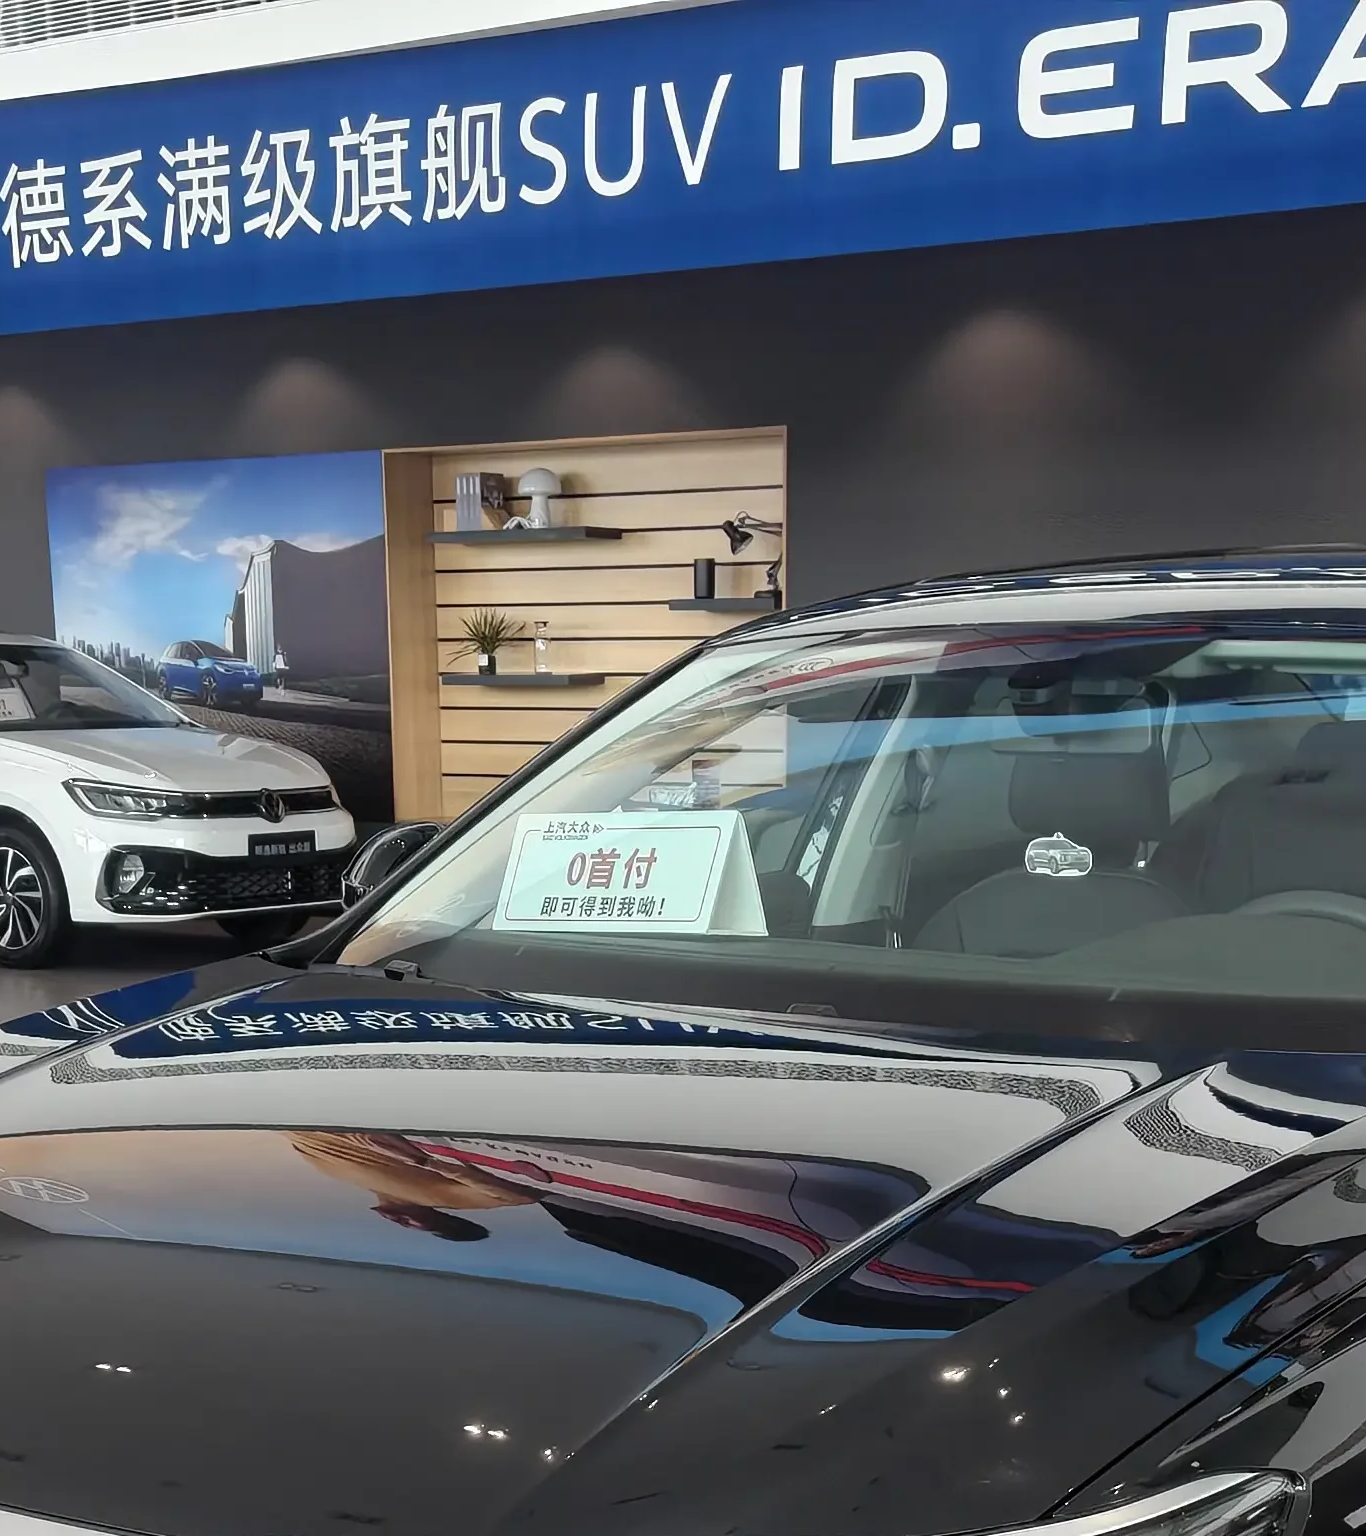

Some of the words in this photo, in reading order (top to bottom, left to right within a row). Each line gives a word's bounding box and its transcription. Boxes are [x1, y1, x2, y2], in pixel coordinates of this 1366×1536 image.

[0, 73, 733, 270] 德系满级旗舰SUV
[543, 820, 591, 834] 上汽大众
[566, 847, 658, 889] 0首付
